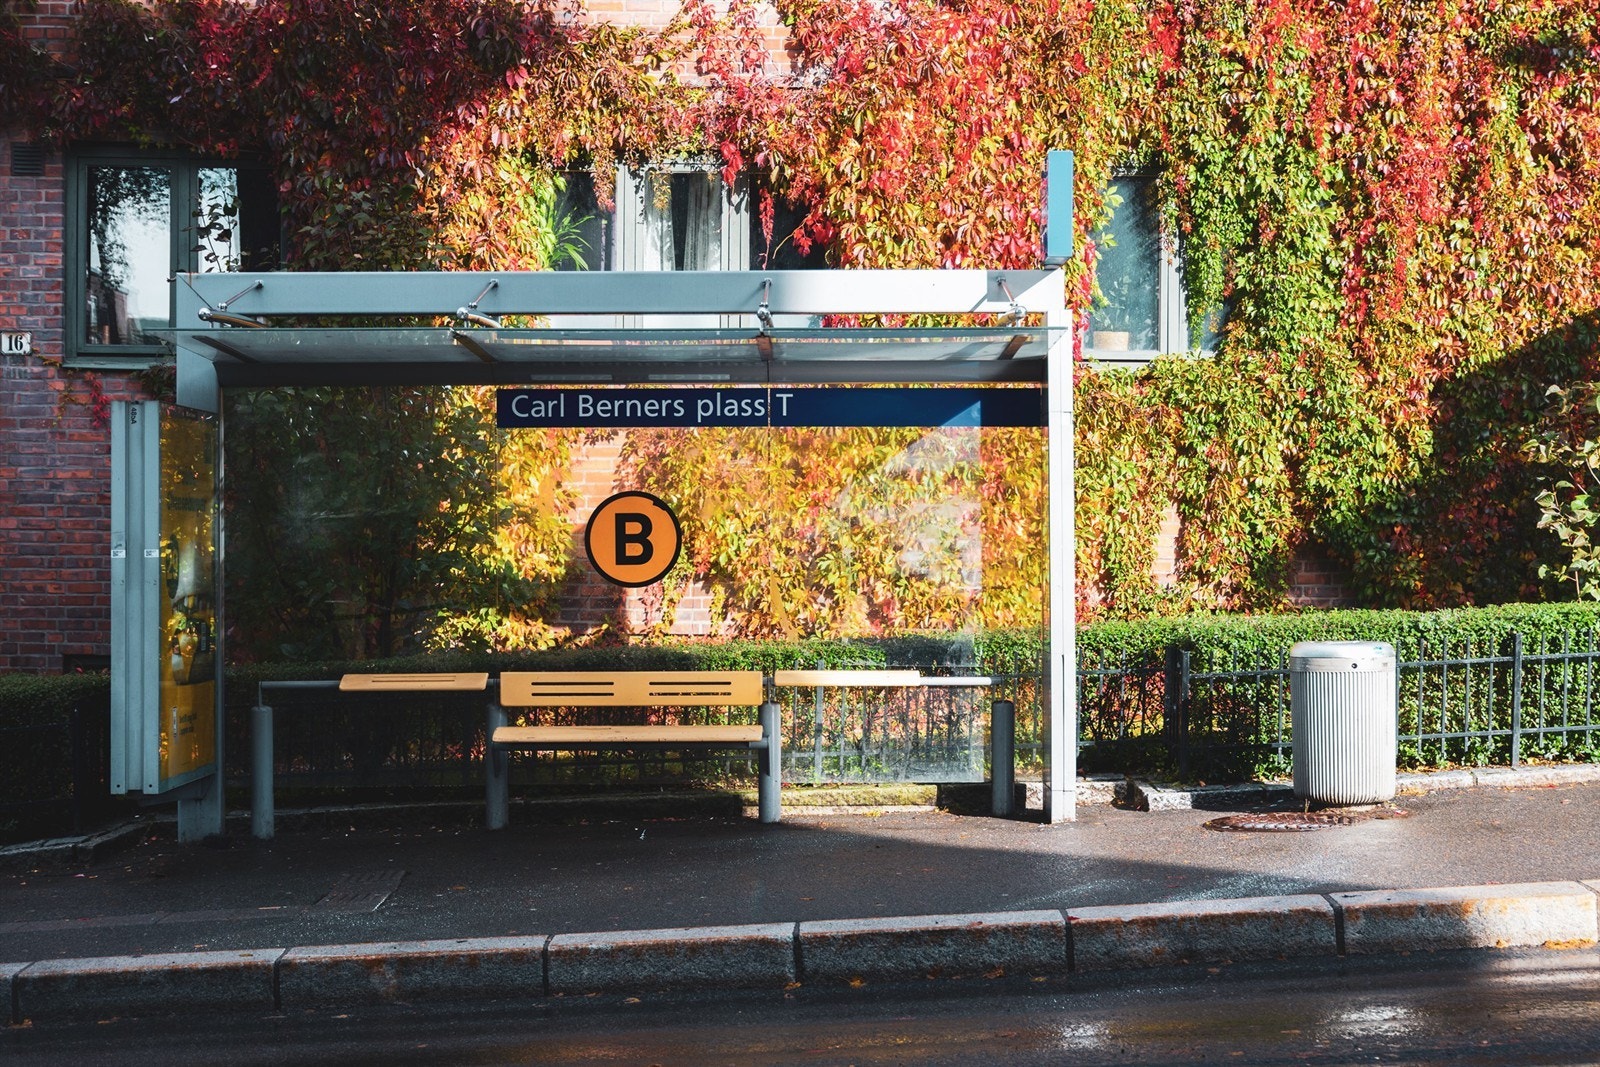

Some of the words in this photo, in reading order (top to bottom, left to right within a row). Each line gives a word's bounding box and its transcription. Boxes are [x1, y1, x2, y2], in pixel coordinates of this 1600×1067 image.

[8, 334, 24, 351] 16
[511, 393, 565, 418] Carl
[578, 394, 685, 417] Berners
[697, 392, 766, 423] plass
[775, 393, 794, 416] T
[614, 512, 654, 566] B
